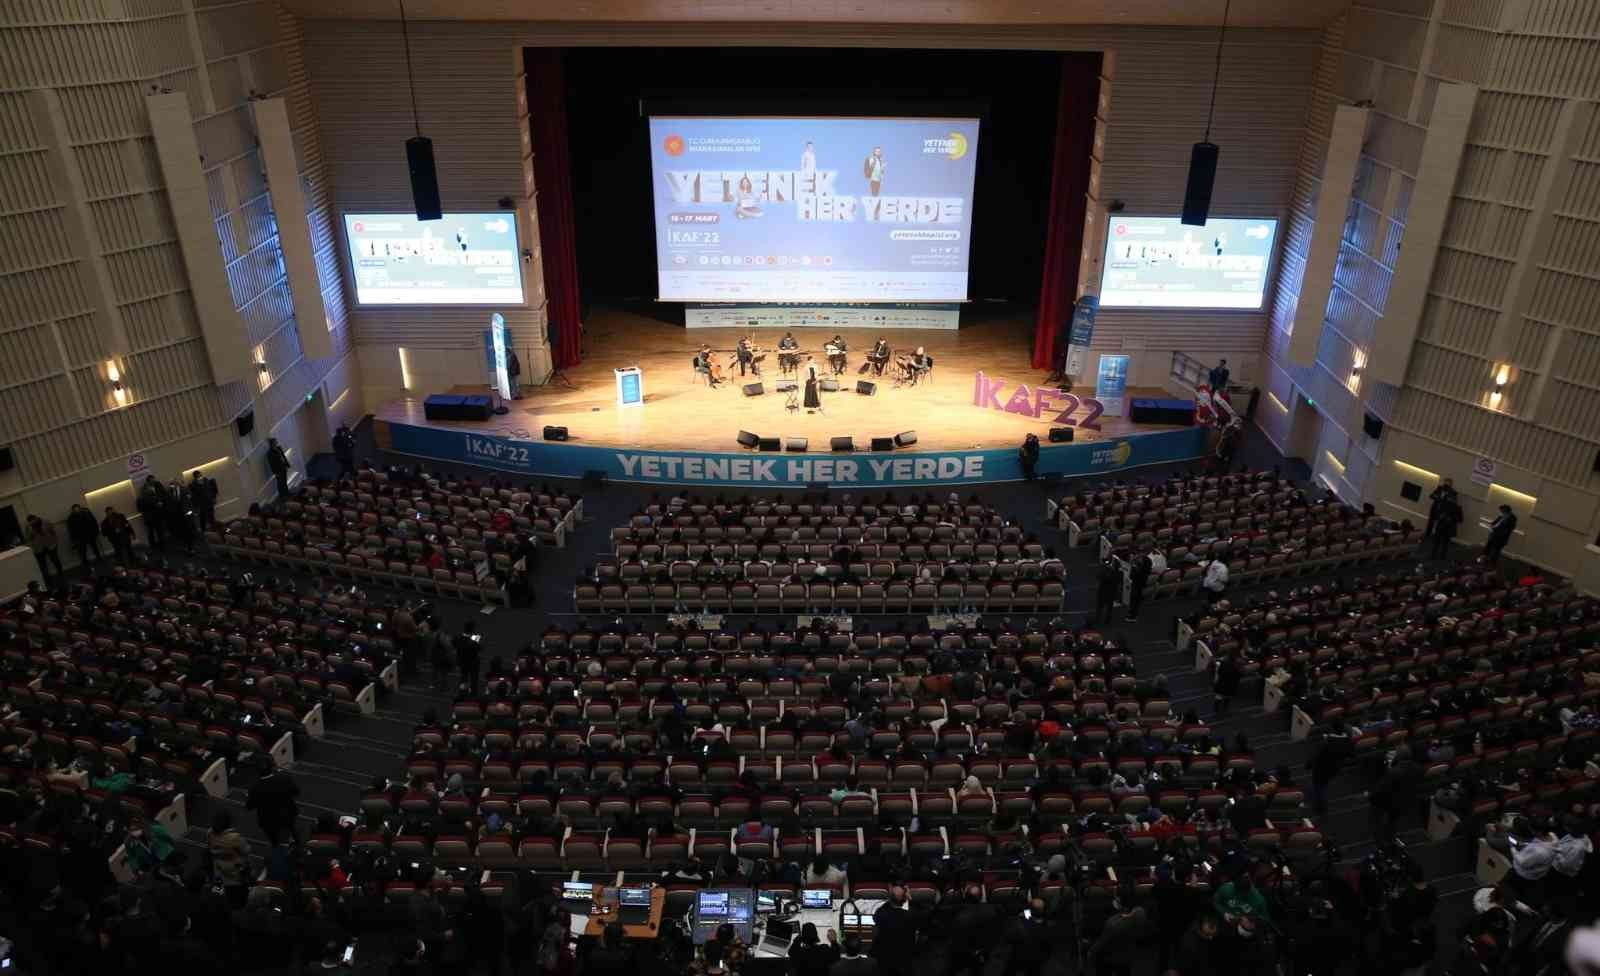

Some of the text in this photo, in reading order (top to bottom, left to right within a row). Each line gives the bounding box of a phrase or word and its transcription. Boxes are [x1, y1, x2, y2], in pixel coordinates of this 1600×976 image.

[665, 171, 837, 202] YETENEK
[799, 197, 963, 222] HER YERDE
[616, 453, 985, 482] YETENEK HER YERDE
